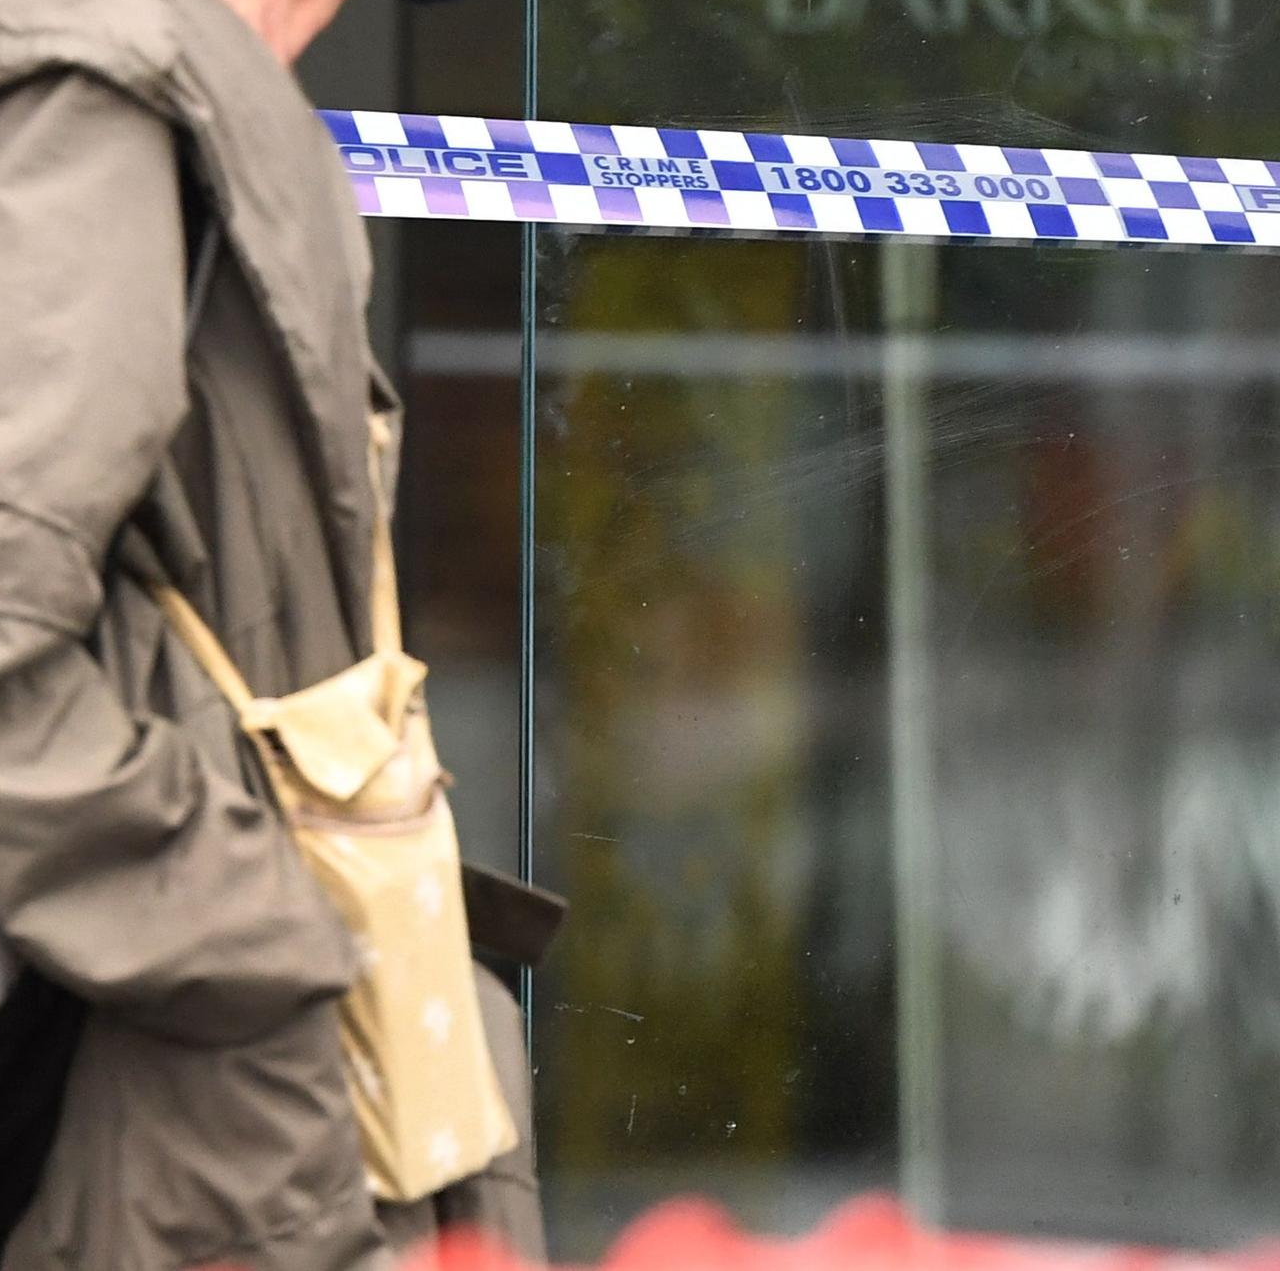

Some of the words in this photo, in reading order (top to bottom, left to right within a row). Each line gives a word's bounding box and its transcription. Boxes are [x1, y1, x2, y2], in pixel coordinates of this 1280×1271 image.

[593, 155, 702, 174] CRIME
[601, 171, 710, 189] STOPPERS
[769, 165, 872, 193] 1800
[885, 171, 963, 197] 333
[975, 175, 1052, 201] 000
